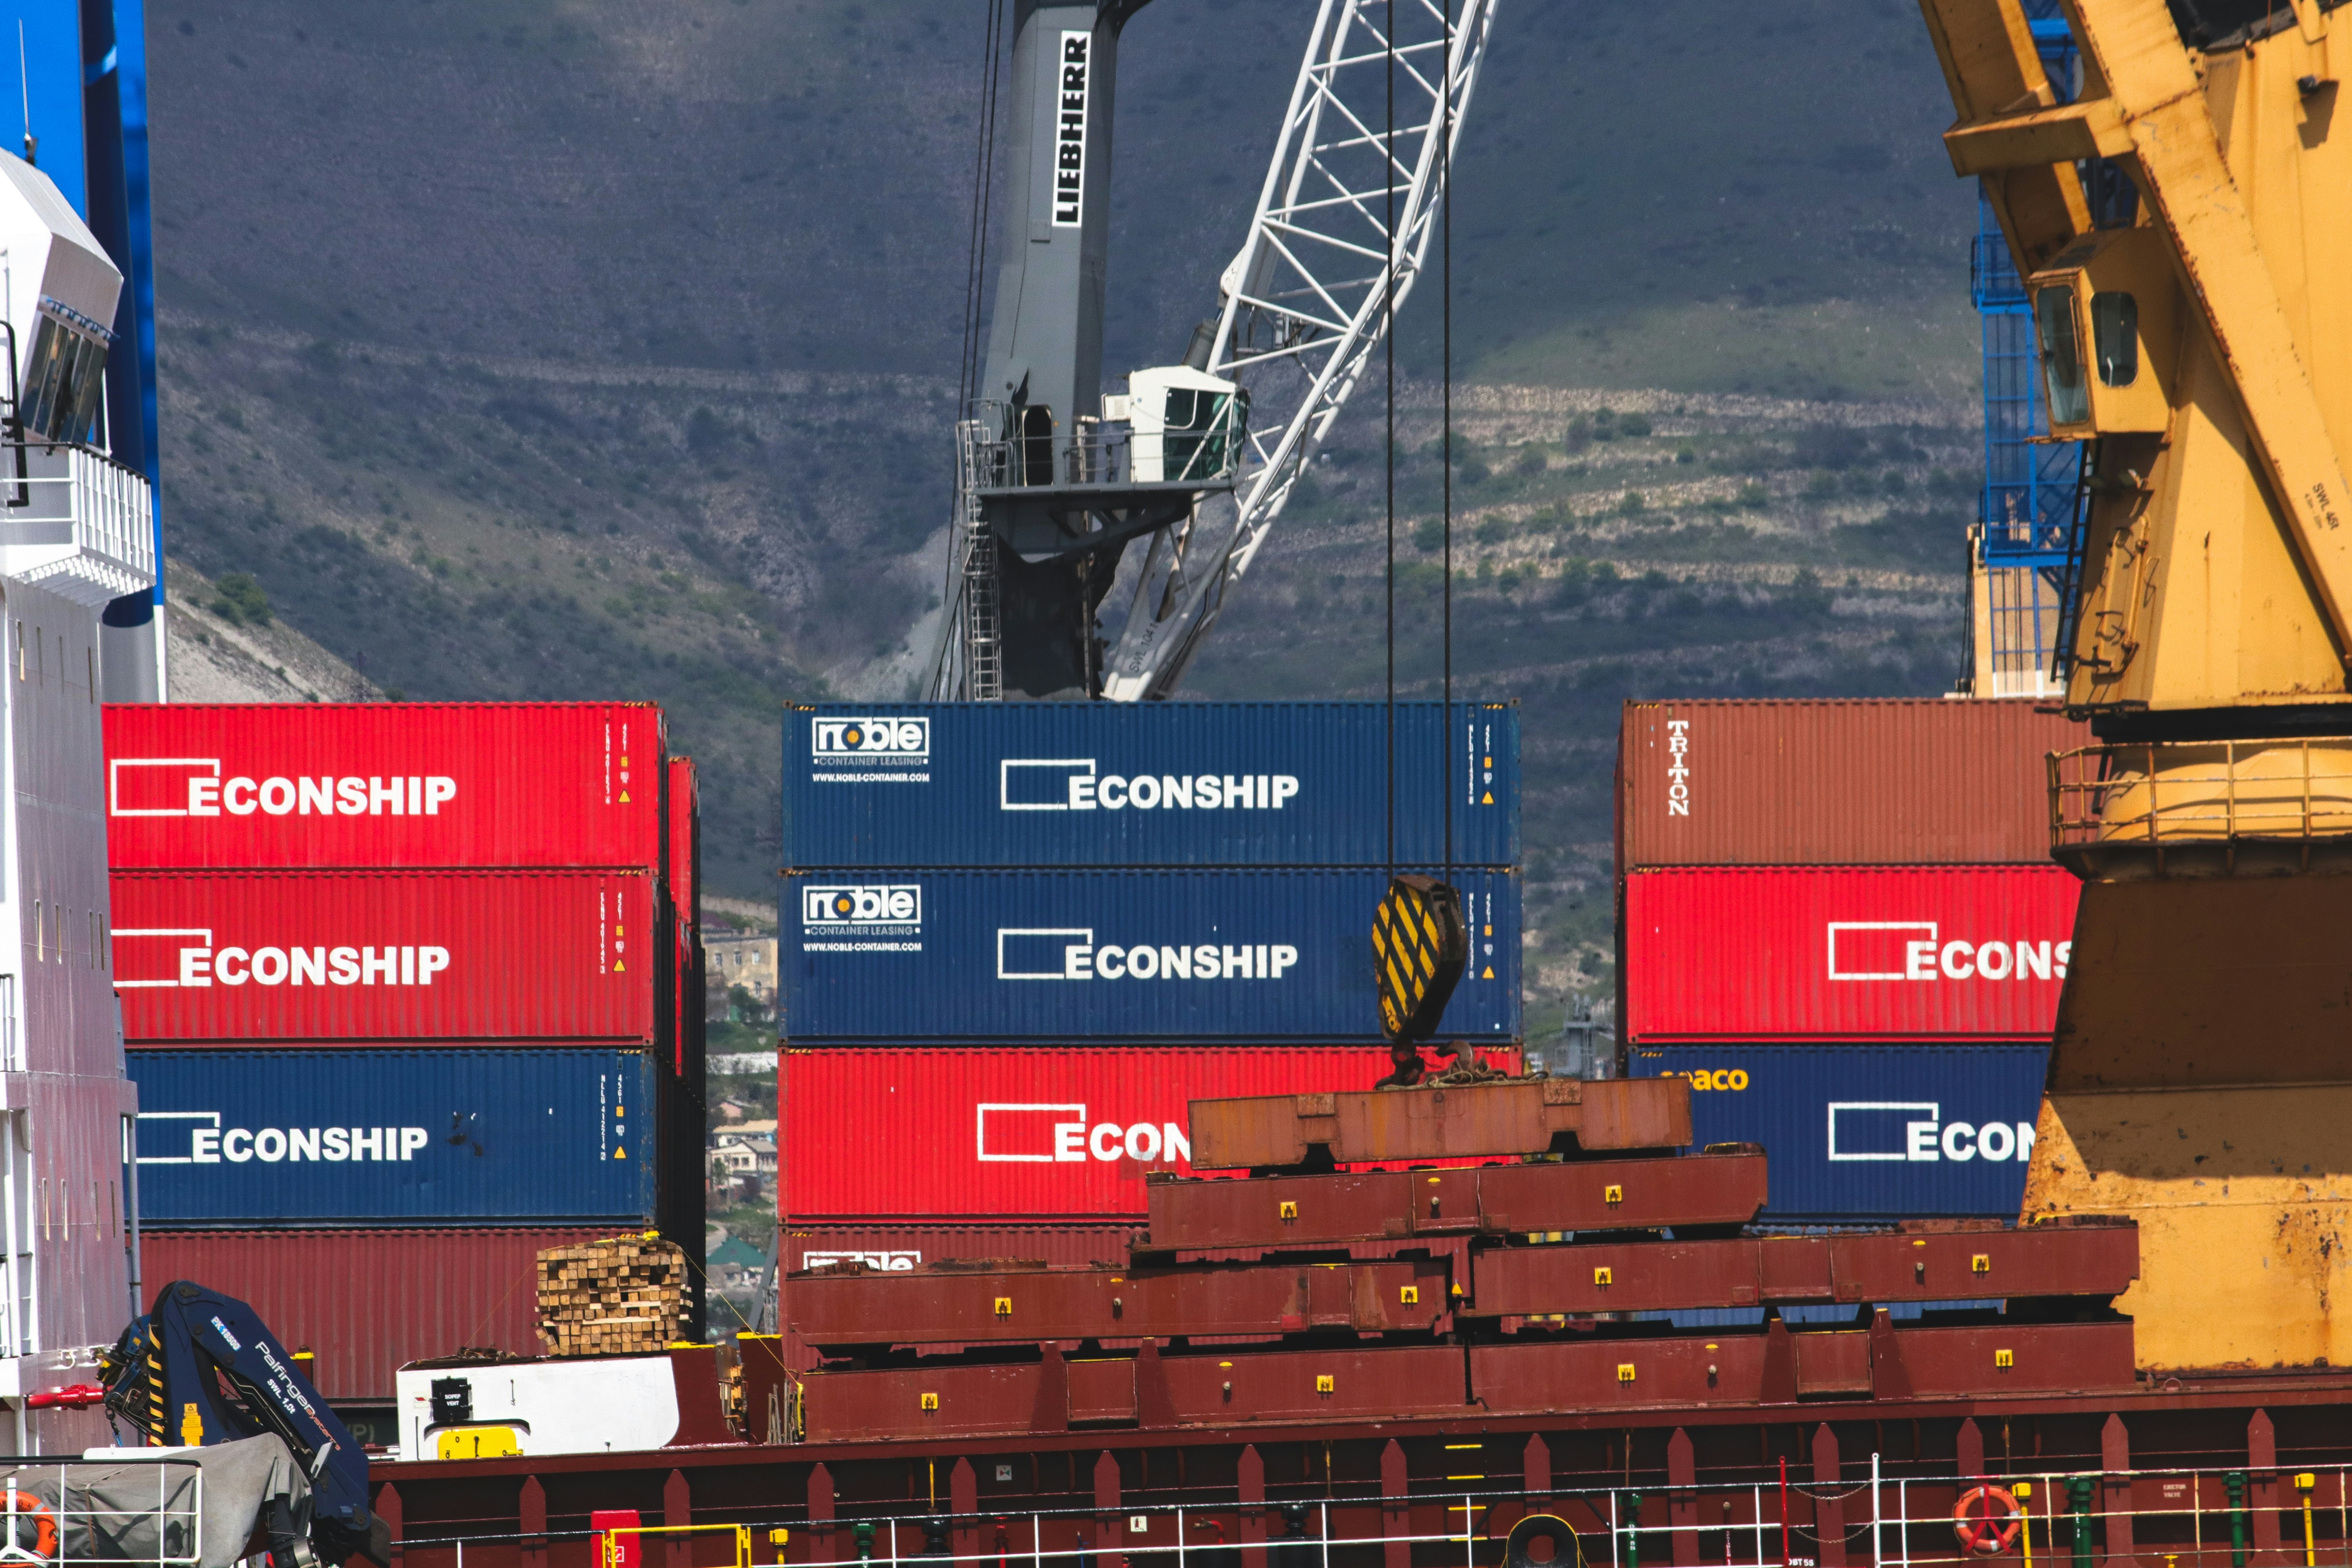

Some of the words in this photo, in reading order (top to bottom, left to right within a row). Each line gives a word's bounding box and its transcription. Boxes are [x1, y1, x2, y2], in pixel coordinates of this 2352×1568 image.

[1057, 35, 1087, 222] LIEBHERR
[818, 721, 923, 751] noble
[812, 773, 930, 782] WWW.NOBLE-CONTAINER.COM
[819, 757, 877, 765] CONTAINER
[880, 757, 922, 765] LEASING
[1668, 720, 1689, 816] TRITON
[188, 776, 456, 816] ECONSHIP
[1069, 775, 1299, 810] ECONSHIP
[810, 889, 914, 919] noble
[803, 942, 922, 951] WWW.NOBLE-CONTAINER.COM
[810, 926, 869, 935] CONTAINER
[871, 926, 913, 935] LEASING
[180, 946, 450, 987] ECONSHIP
[1065, 945, 1297, 979] ECONSHIP
[1661, 1069, 1749, 1091] aco
[193, 1127, 428, 1163] ECONSHIP
[1055, 1123, 1191, 1162] ECON
[211, 1316, 223, 1330] PK
[221, 1327, 241, 1351] 18500
[255, 1341, 316, 1415] Palfinger
